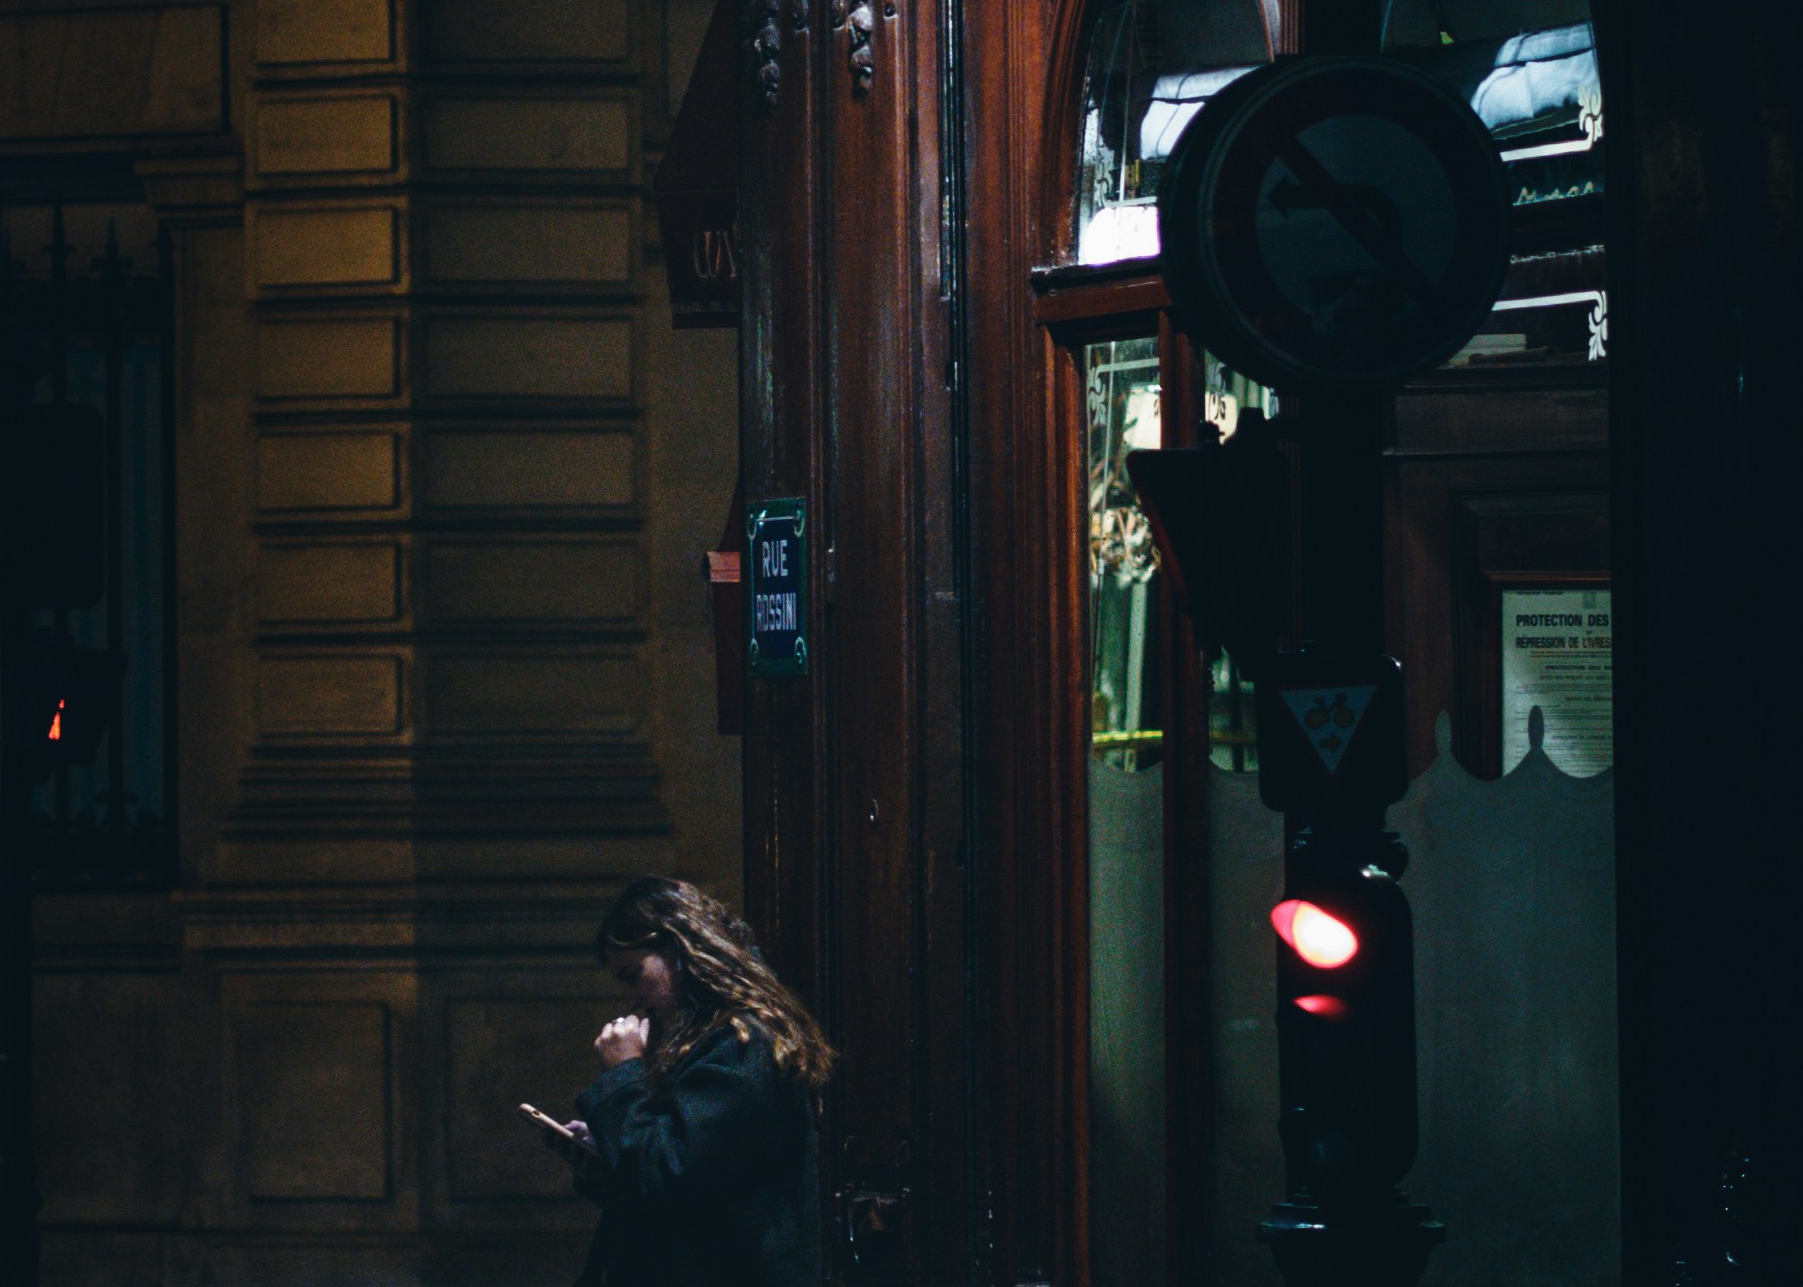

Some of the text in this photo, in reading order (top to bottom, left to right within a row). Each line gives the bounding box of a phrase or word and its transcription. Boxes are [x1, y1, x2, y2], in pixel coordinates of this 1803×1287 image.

[762, 539, 790, 578] RUE
[755, 592, 797, 632] ROSSINI
[1515, 614, 1610, 627] PROTECTION DES
[1568, 636, 1580, 649] DE
